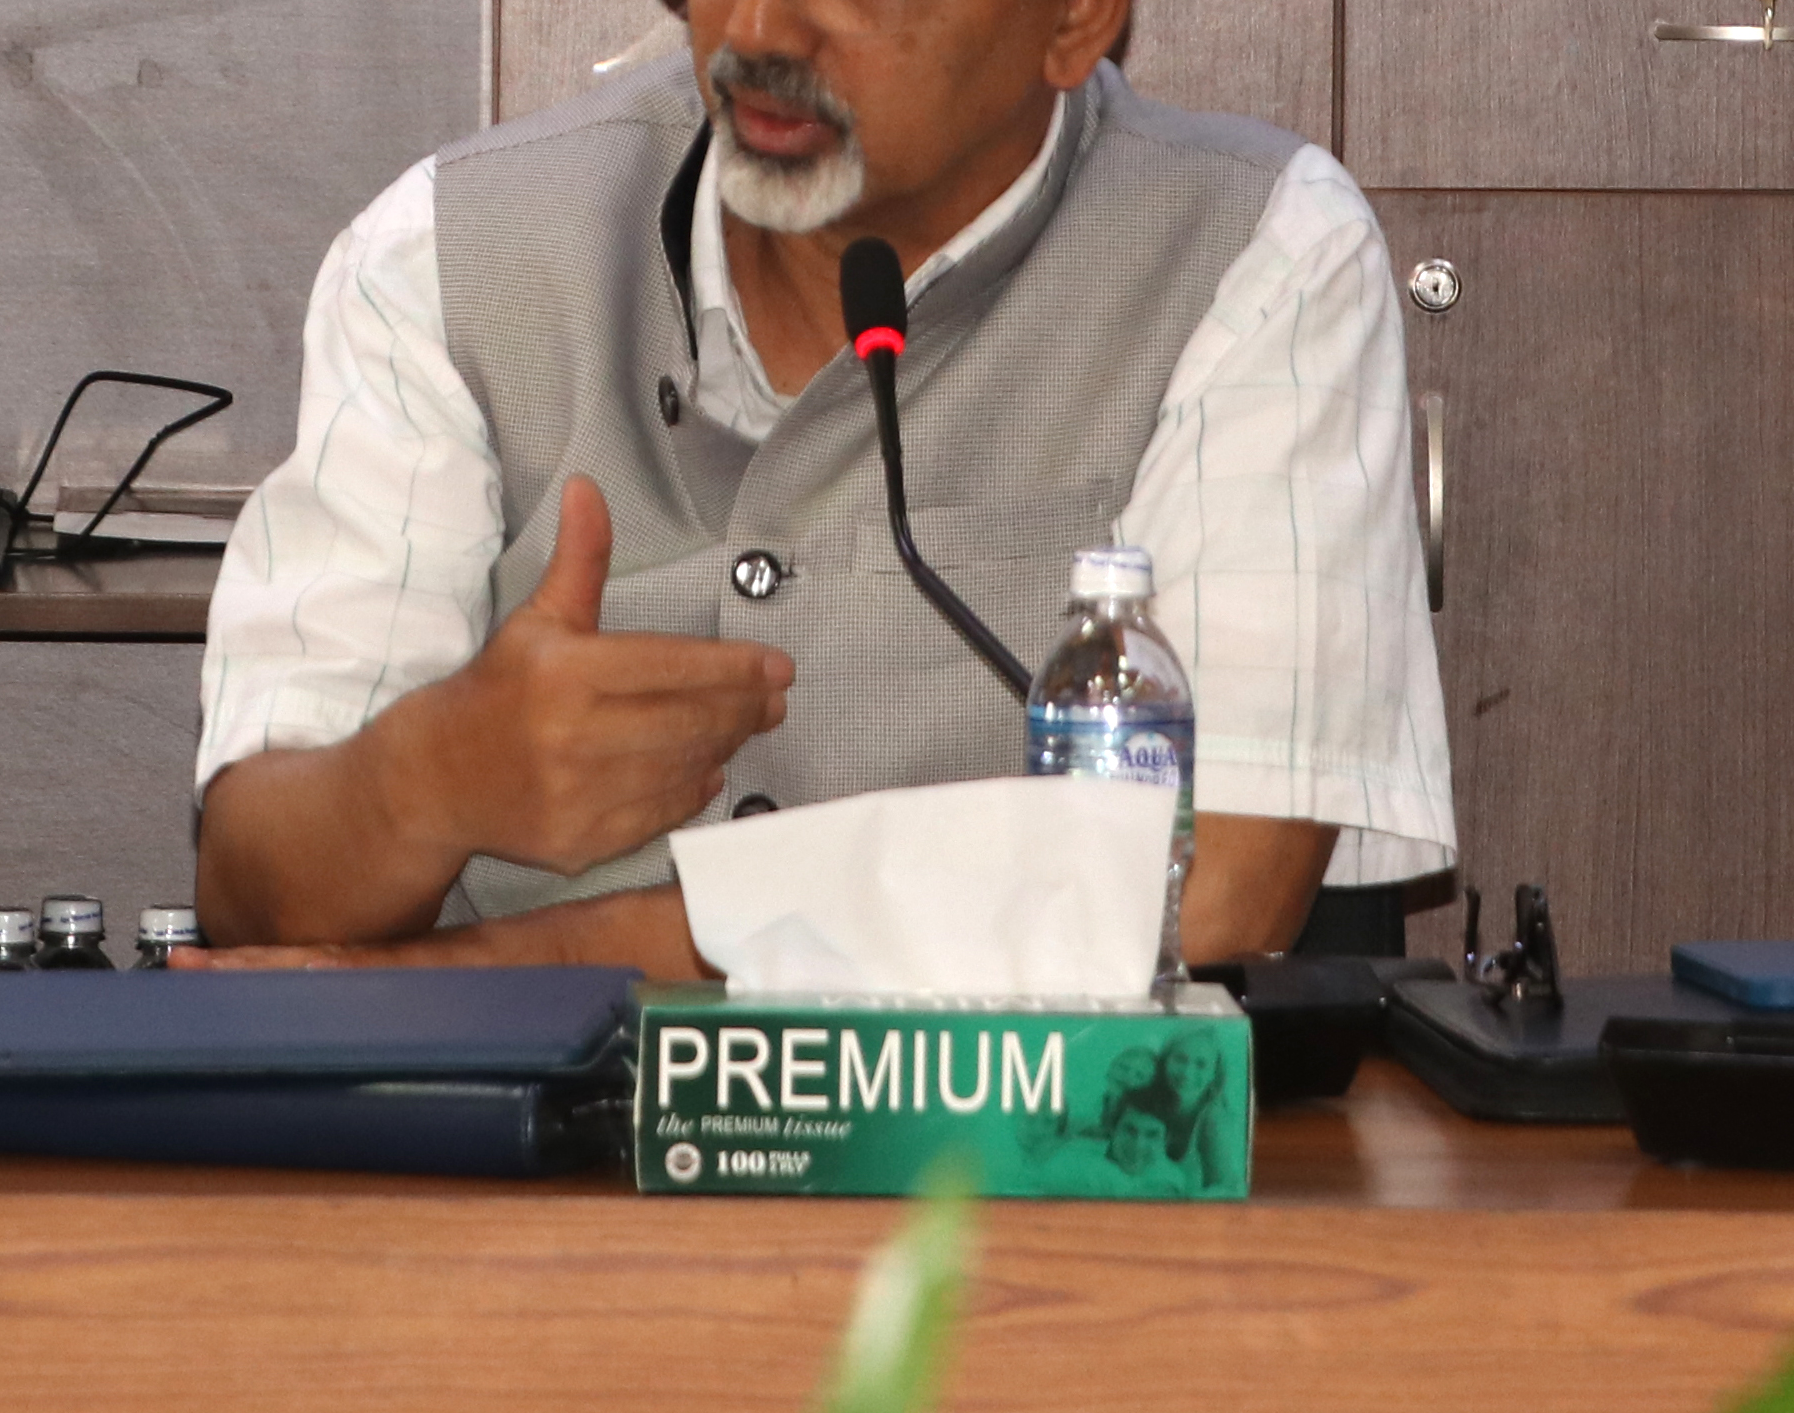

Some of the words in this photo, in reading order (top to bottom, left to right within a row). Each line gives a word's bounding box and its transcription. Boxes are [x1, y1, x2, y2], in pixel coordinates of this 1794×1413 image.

[1119, 745, 1177, 771] AQUA
[656, 1026, 1066, 1115] PREMIUM
[656, 1113, 693, 1136] the
[701, 1116, 778, 1133] PREMIUM
[783, 1115, 851, 1139] tissue
[718, 1150, 766, 1175] 100
